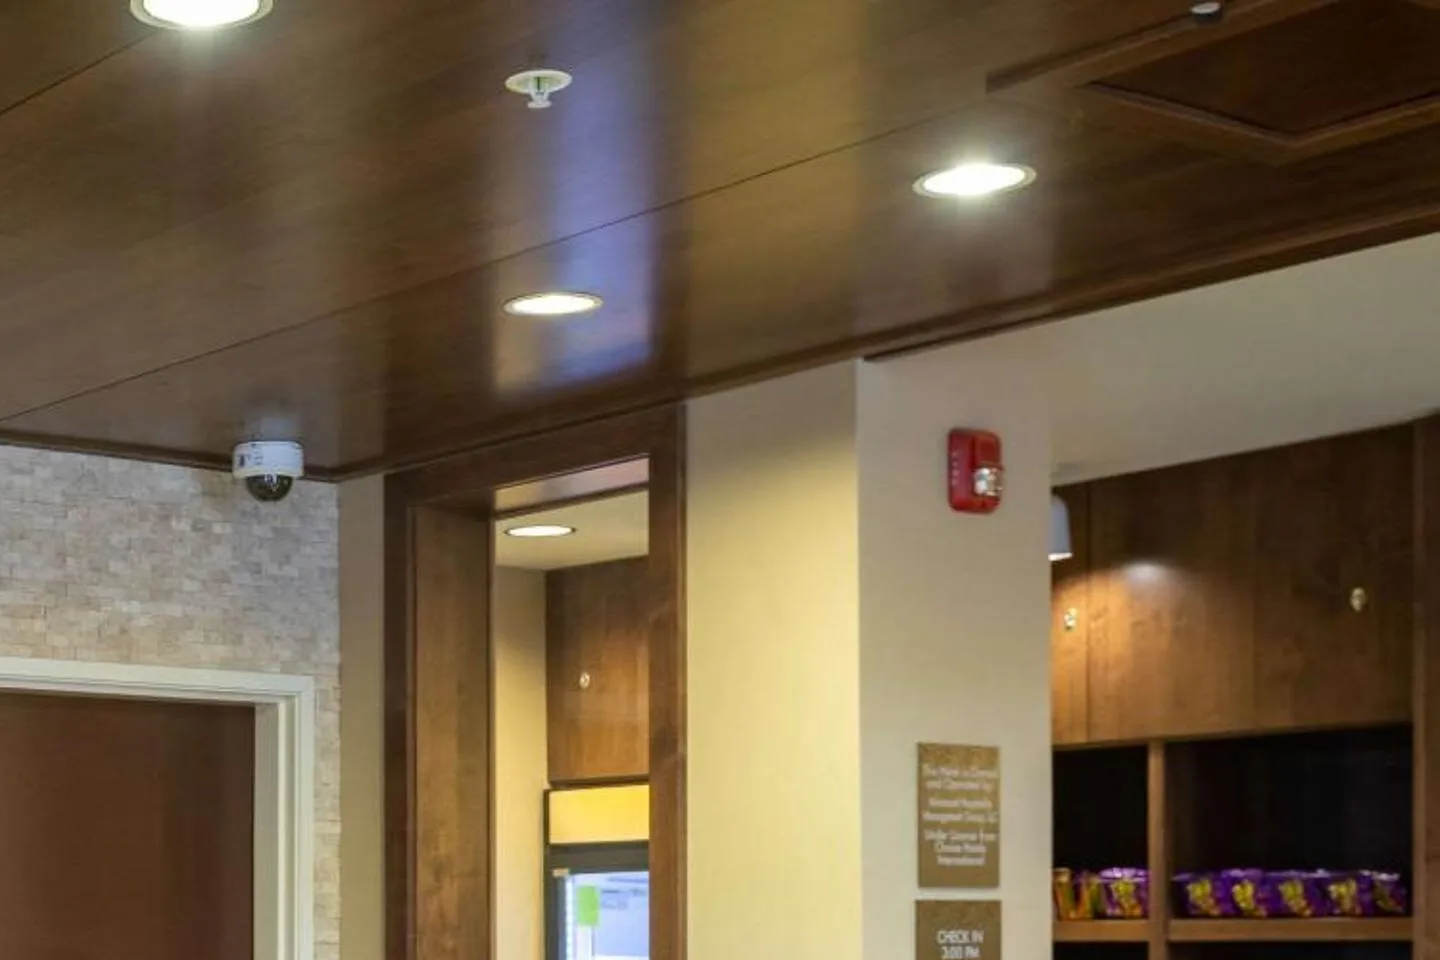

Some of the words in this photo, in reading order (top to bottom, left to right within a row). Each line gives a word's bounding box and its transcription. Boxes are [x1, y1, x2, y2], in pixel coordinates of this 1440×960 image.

[936, 930, 970, 944] CHECK
[971, 930, 985, 945] IN
[965, 946, 980, 958] PM
